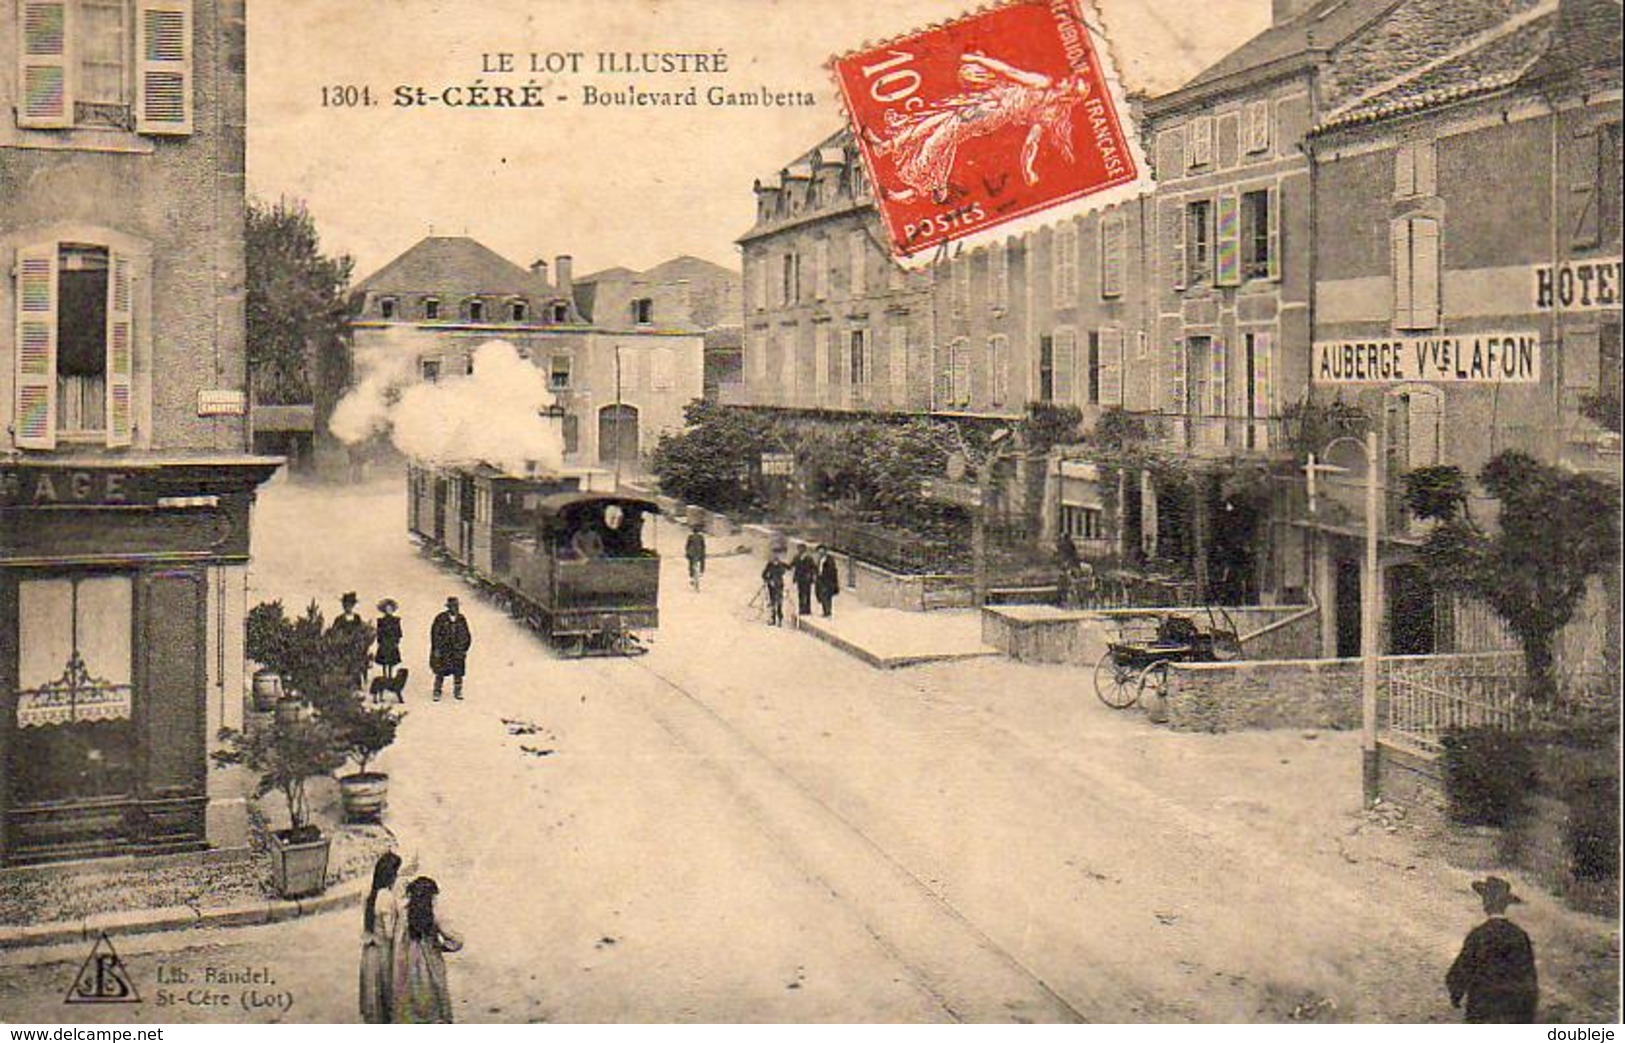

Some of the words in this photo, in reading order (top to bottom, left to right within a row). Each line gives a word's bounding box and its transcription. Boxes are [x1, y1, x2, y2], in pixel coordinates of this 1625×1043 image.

[903, 202, 985, 241] POSTES
[1320, 342, 1403, 379] AUBERGE
[1455, 337, 1537, 379] LAFON
